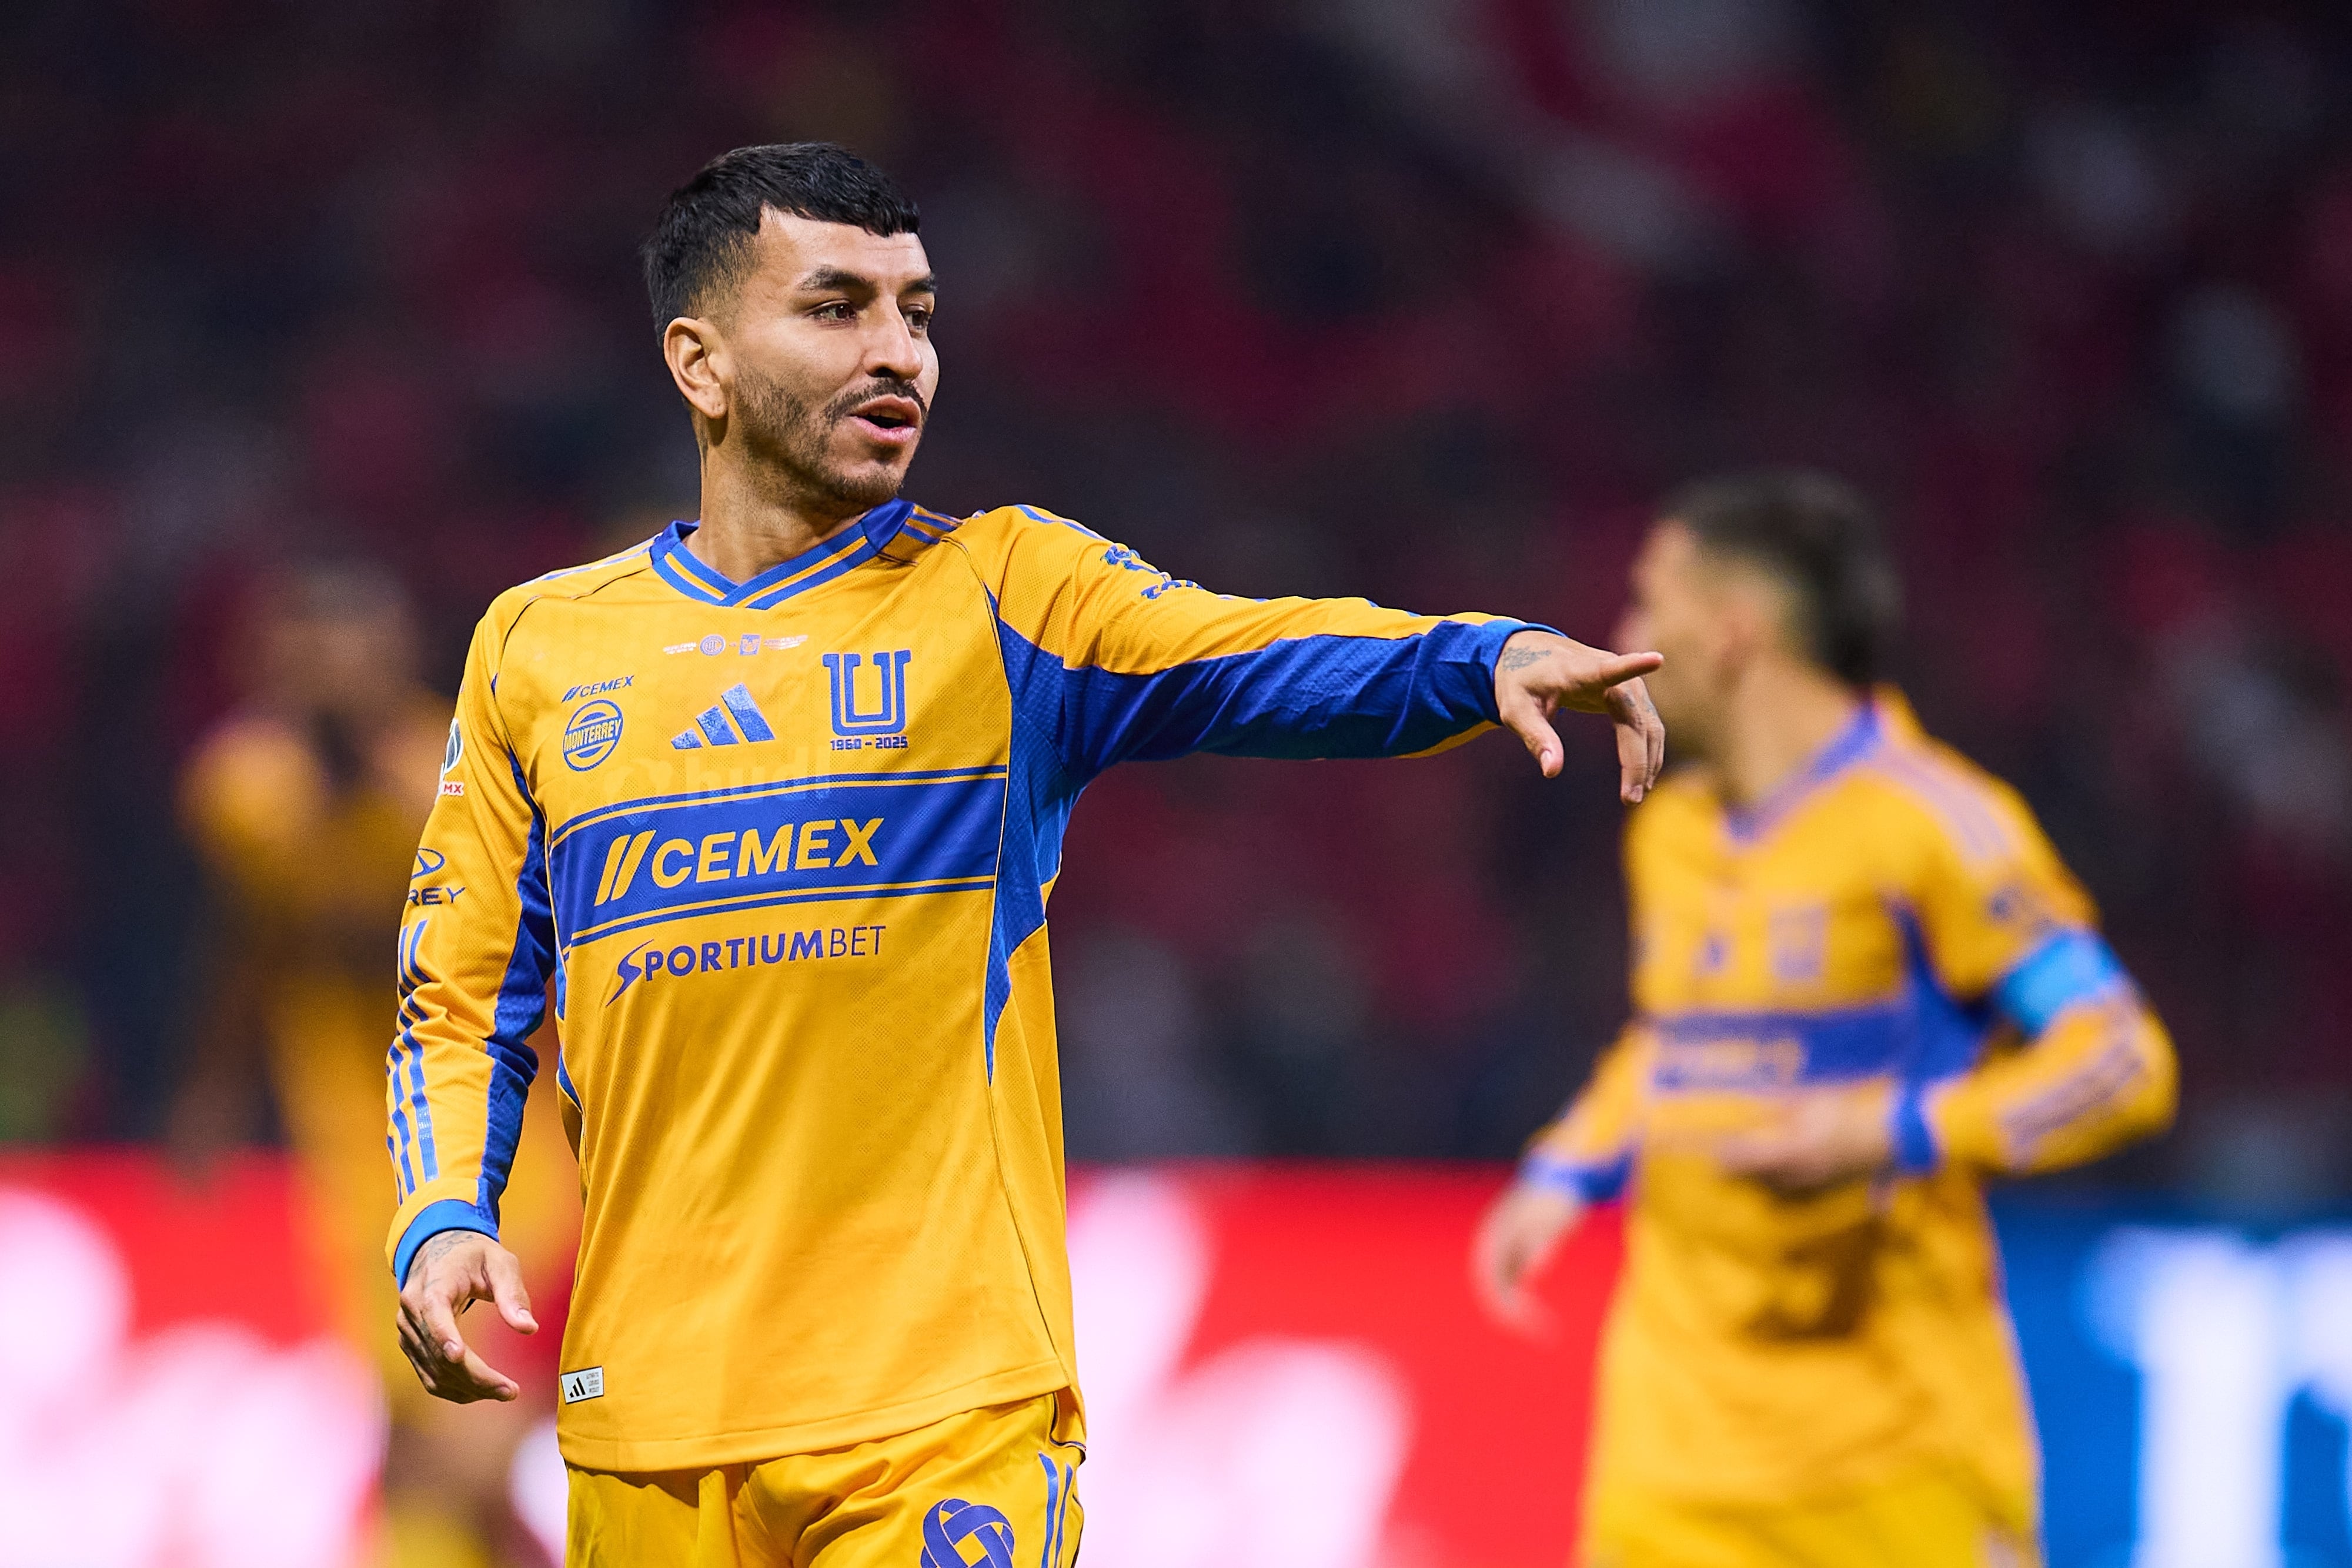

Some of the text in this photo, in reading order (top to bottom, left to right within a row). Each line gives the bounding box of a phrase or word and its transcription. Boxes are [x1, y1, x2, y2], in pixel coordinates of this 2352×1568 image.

[580, 675, 634, 697] CEMEX
[823, 650, 911, 735] U
[563, 718, 622, 752] MONTERREY
[830, 738, 861, 750] 1960
[876, 736, 908, 748] 2025
[444, 784, 462, 793] MX
[652, 818, 884, 888] CEMEX
[606, 925, 886, 1007] SPORTIUMBET
